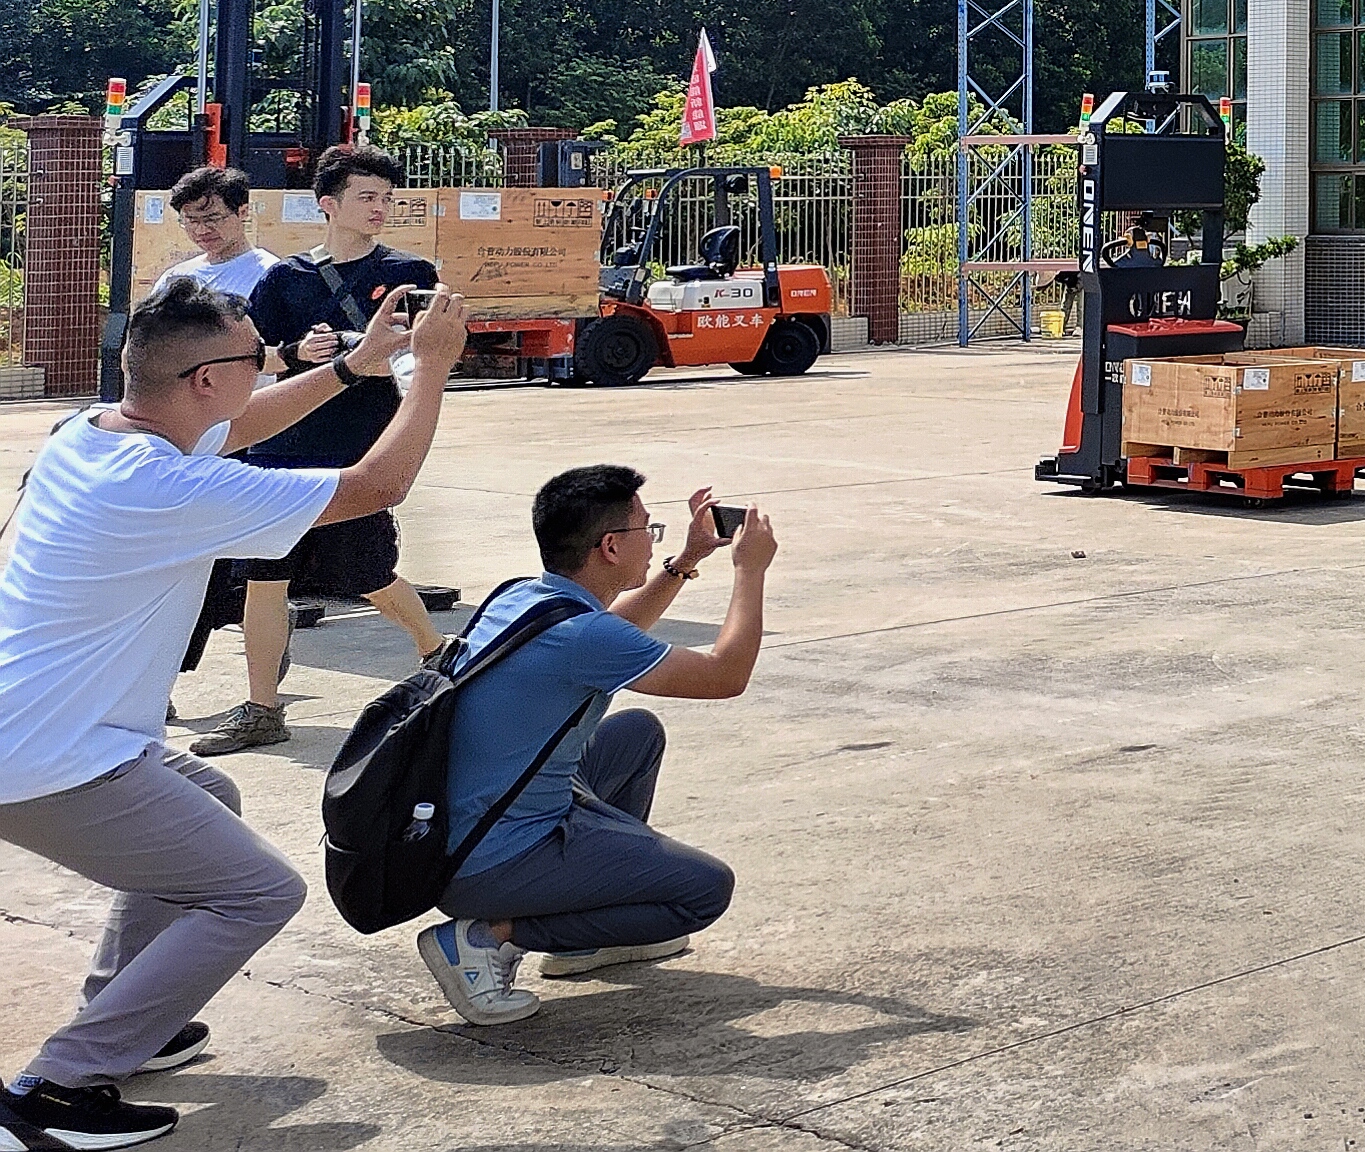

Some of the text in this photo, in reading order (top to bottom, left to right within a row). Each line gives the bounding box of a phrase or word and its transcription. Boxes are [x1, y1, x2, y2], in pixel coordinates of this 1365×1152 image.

[1083, 179, 1095, 274] ONEN
[697, 313, 764, 328] 欧能叉车
